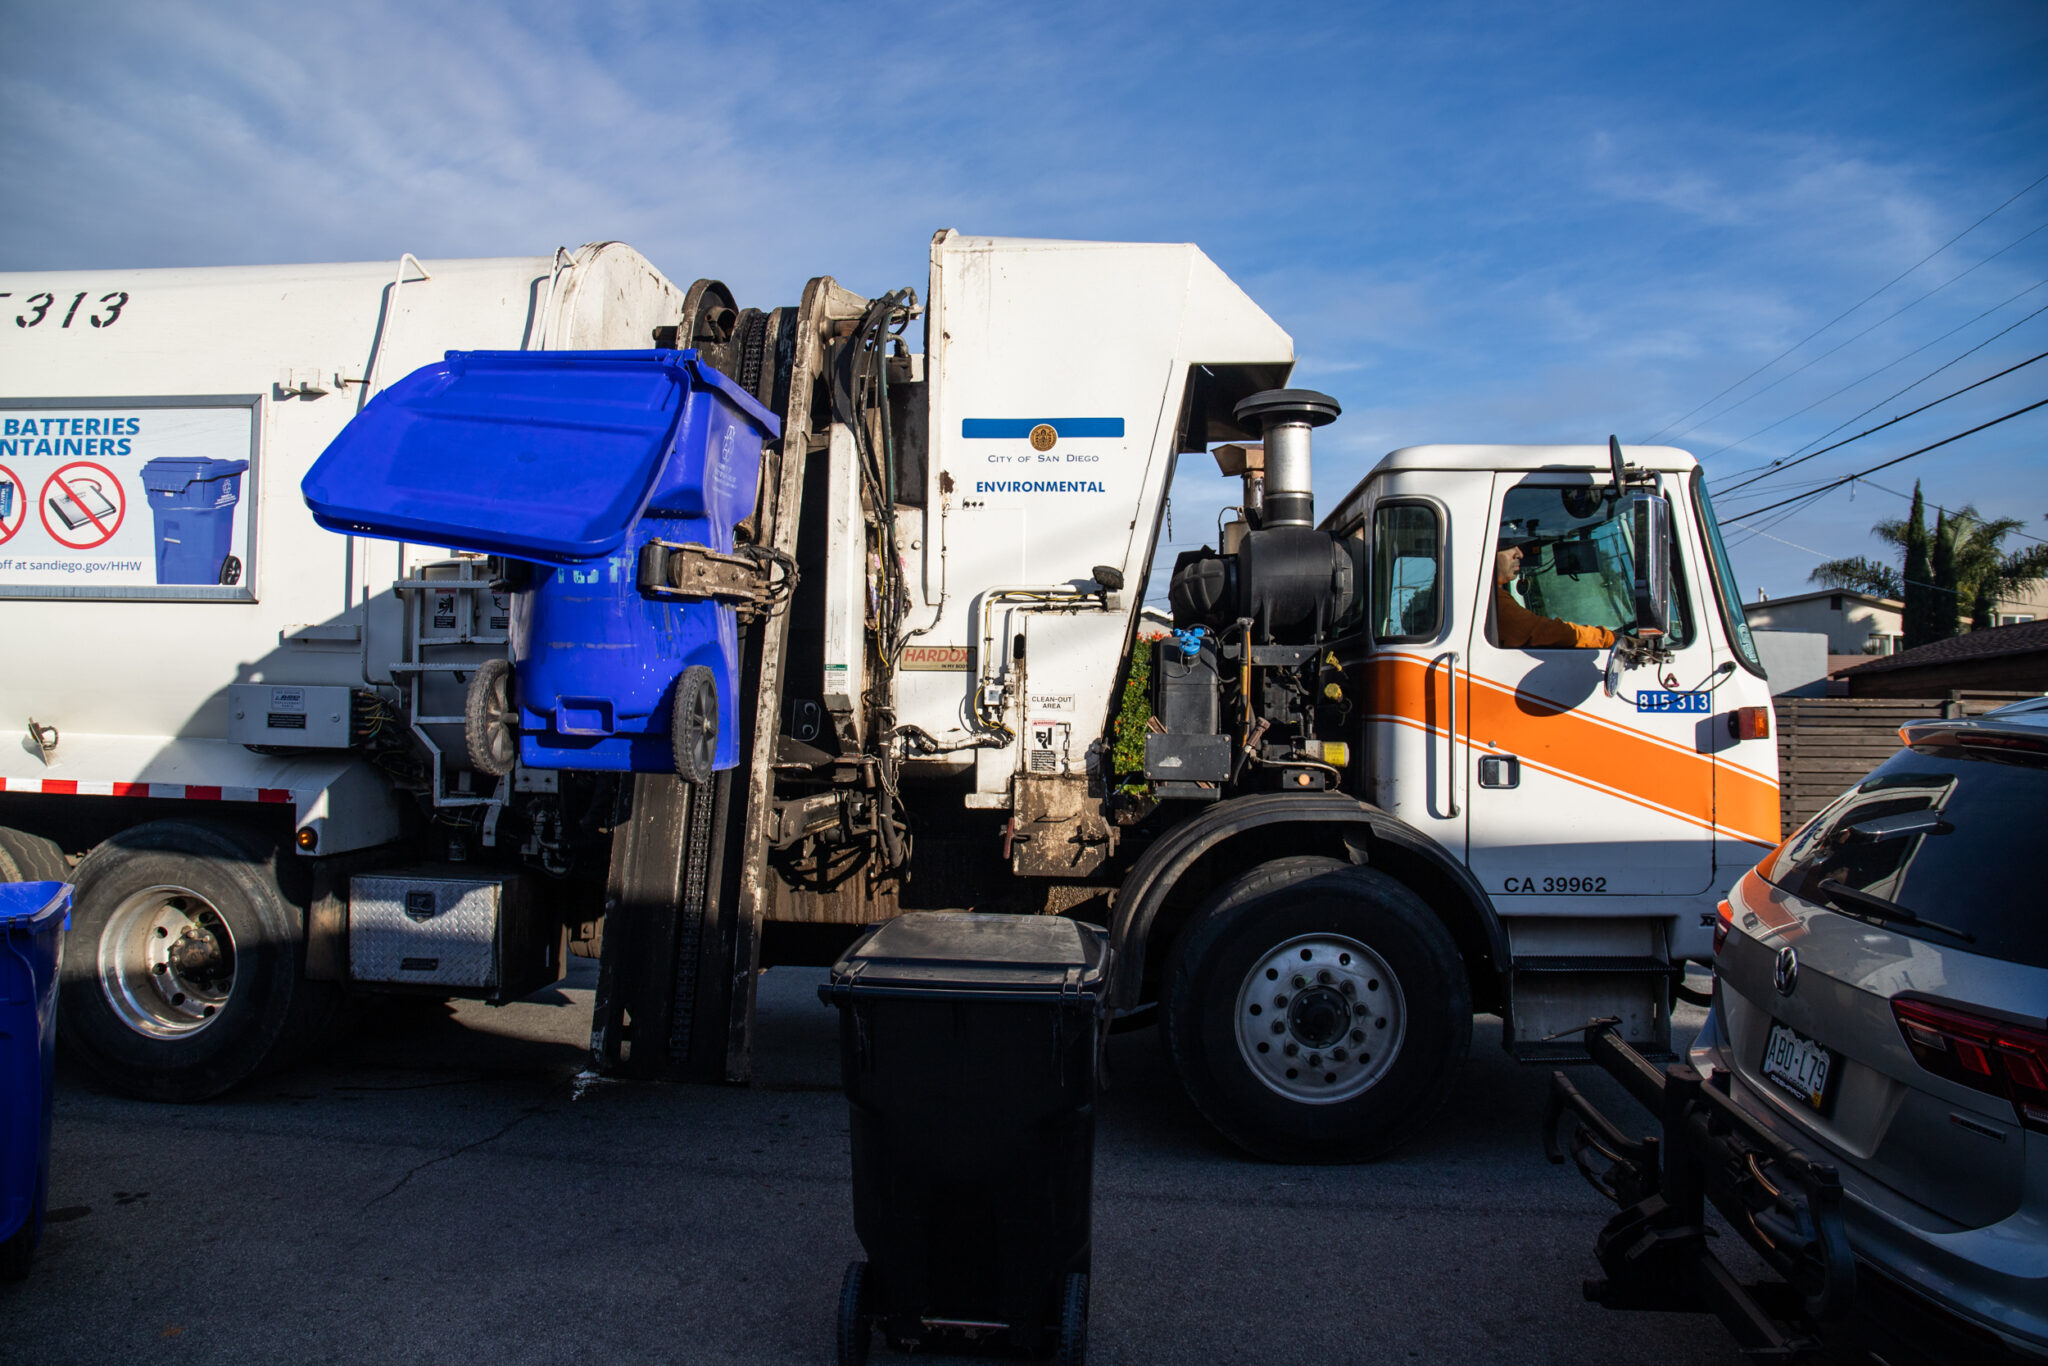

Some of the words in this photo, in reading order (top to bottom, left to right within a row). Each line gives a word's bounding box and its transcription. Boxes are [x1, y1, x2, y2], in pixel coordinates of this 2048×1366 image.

[0, 292, 129, 328] 313
[4, 418, 140, 436] BATTERIES
[0, 438, 131, 456] NTAINERS
[976, 481, 1106, 492] ENVIRONMENTAL
[0, 559, 13, 570] ff
[15, 561, 27, 570] at
[30, 561, 142, 573] sandiego.gov/HHW
[904, 649, 972, 662] HARDOX
[1639, 694, 1670, 710] 815
[1676, 694, 1709, 710] 313
[1504, 877, 1536, 892] CA
[1543, 877, 1607, 892] 39962
